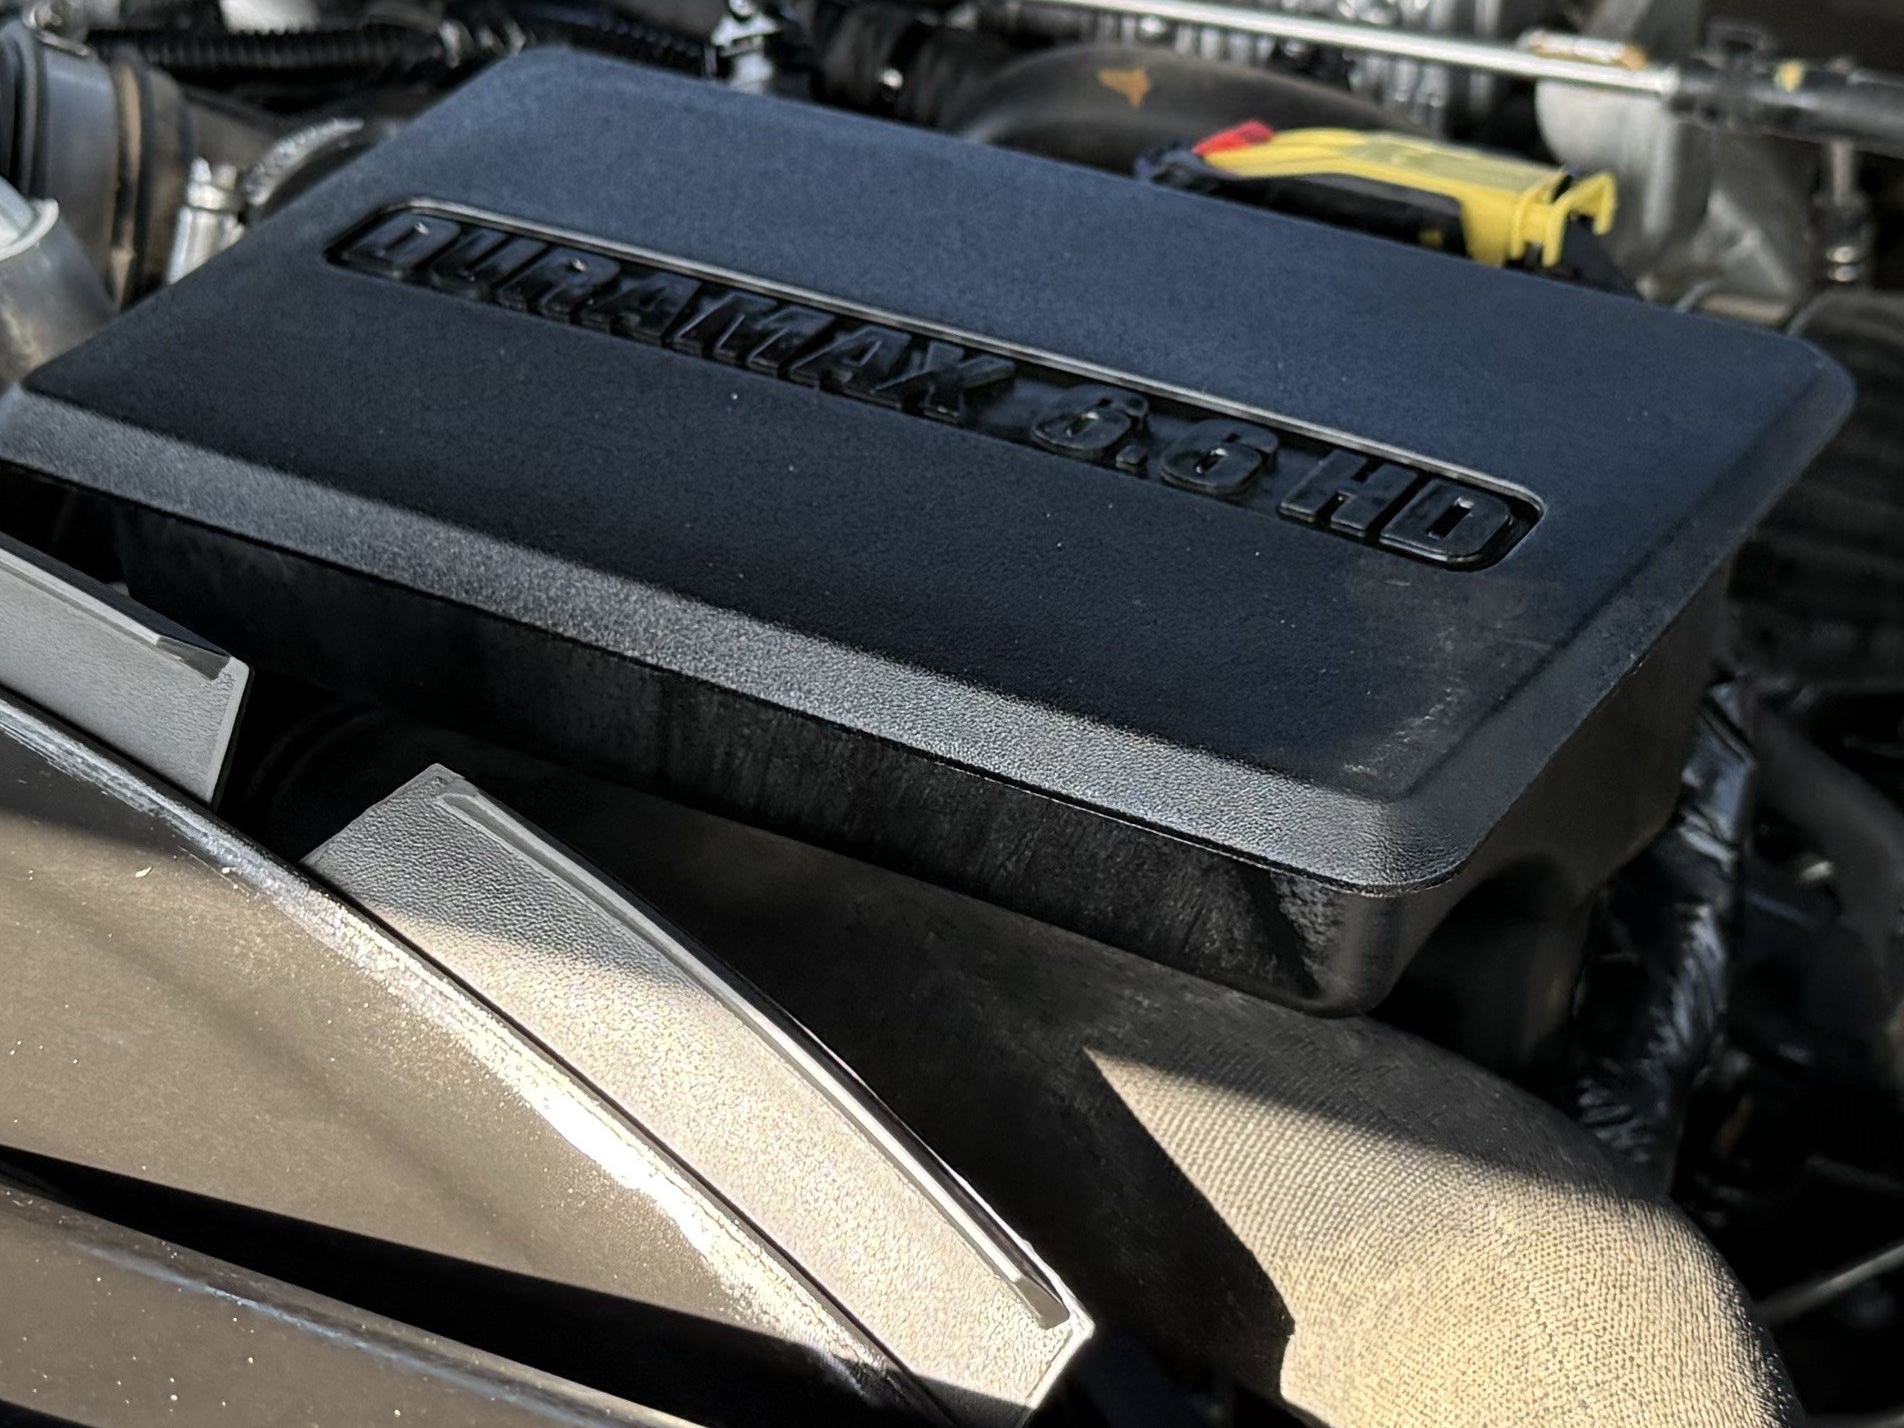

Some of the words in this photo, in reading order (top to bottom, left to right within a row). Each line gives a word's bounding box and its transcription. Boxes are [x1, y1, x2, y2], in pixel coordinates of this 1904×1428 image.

[341, 214, 1014, 420] DURAMAX
[1030, 383, 1279, 494] 6.6
[1277, 449, 1512, 565] HD
